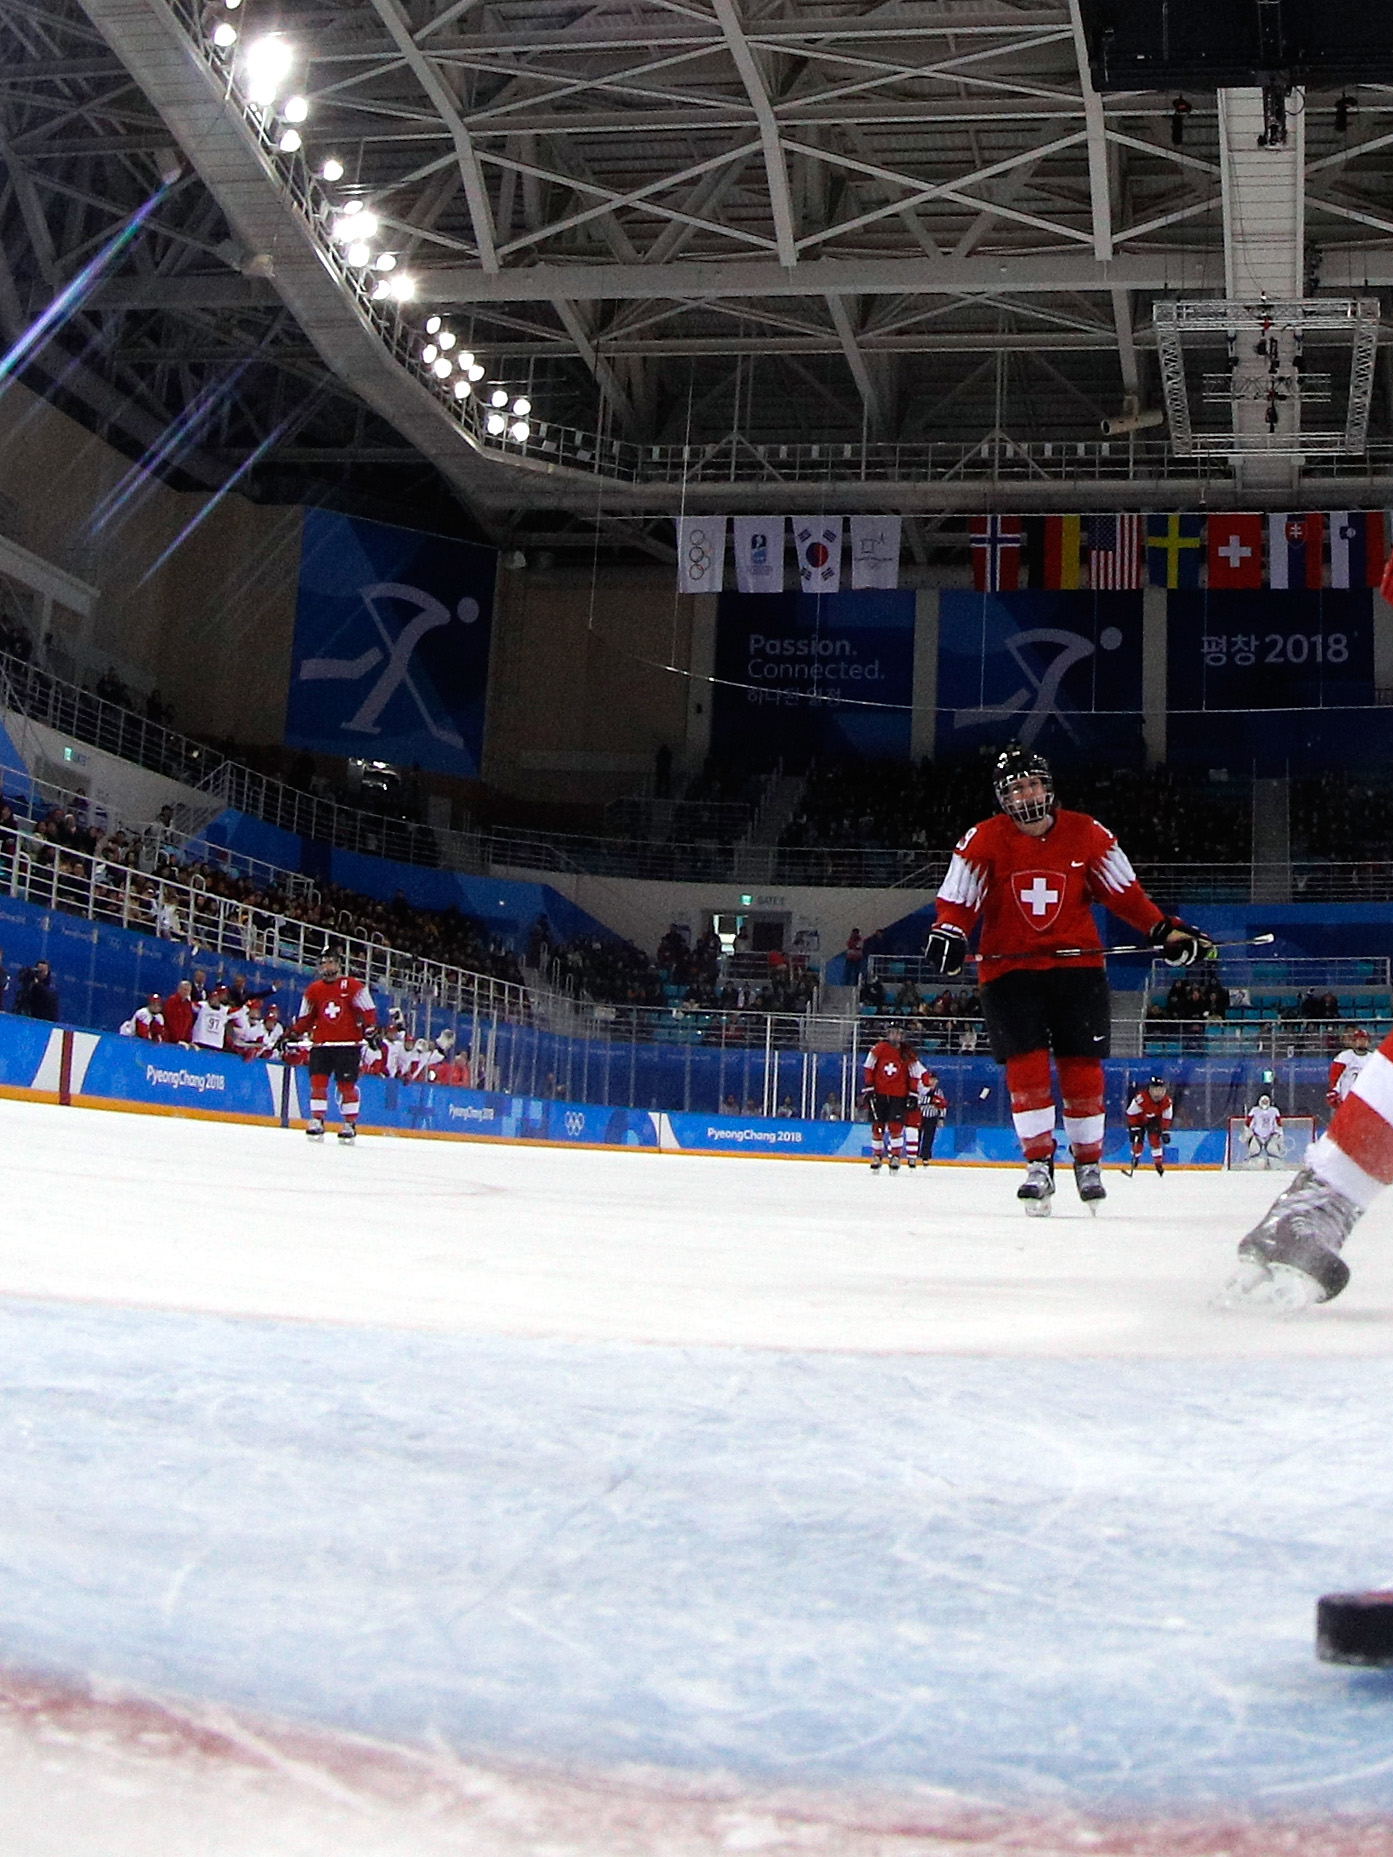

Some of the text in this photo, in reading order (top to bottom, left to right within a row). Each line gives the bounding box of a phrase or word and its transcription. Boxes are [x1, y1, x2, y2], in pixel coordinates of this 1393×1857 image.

[750, 634, 858, 656] Passion.
[1201, 633, 1349, 666] 평창 2018
[748, 658, 885, 680] Connected.
[146, 1064, 206, 1092] PyeongChang
[707, 1127, 802, 1143] PyeongChang 2018
